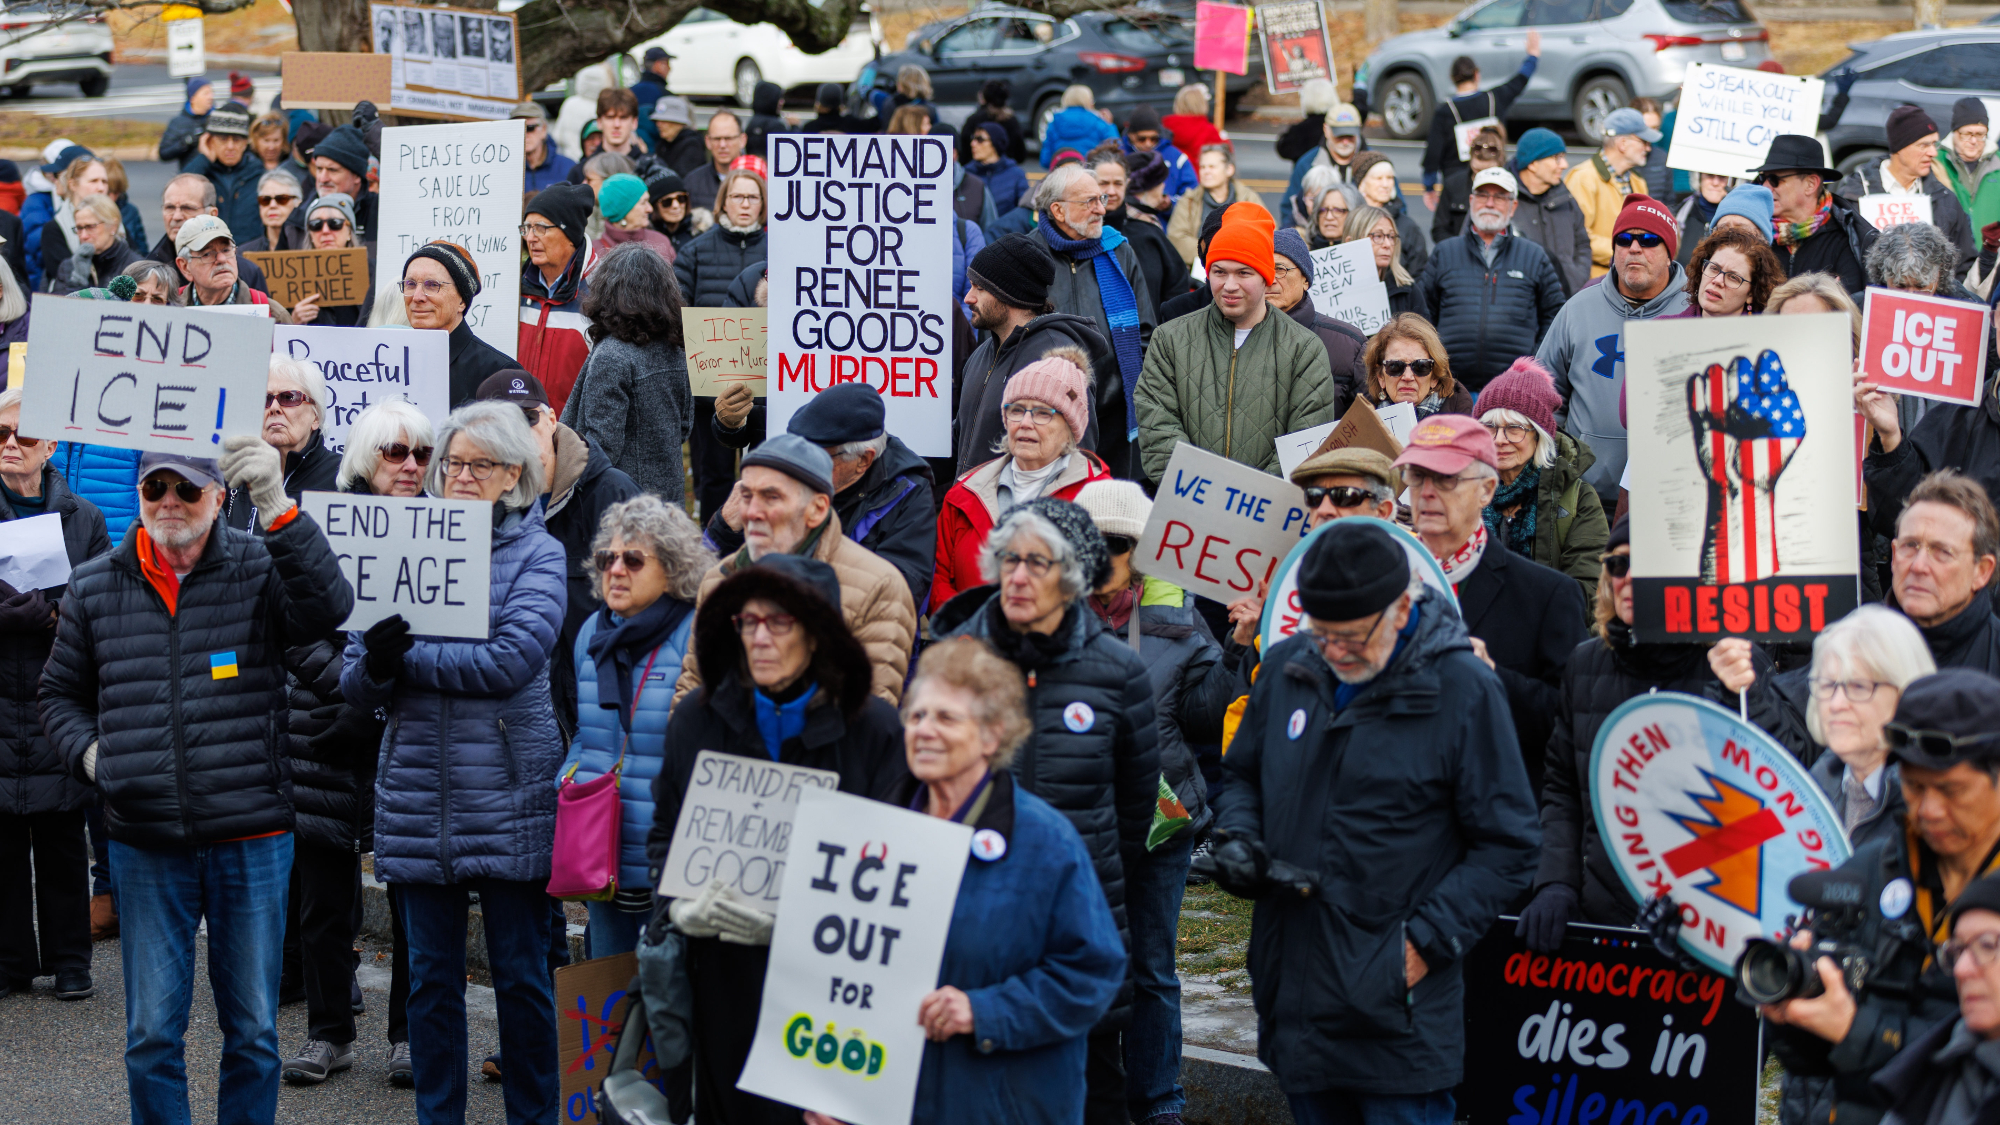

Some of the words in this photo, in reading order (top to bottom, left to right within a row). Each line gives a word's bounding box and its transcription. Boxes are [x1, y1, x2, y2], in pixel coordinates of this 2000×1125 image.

[1698, 93, 1753, 115] WHILE
[1762, 104, 1792, 122] YOU
[1700, 72, 1761, 98] SPEAK
[1764, 83, 1801, 102] OUT
[1688, 117, 1741, 143] STILL
[1746, 125, 1791, 146] CA
[399, 144, 463, 171] PLEASE
[471, 143, 510, 164] GOD
[774, 137, 948, 179] DEMAND
[470, 174, 491, 197] US
[774, 180, 937, 224] JUSTICE
[433, 206, 481, 227] FROM
[1878, 203, 1914, 215] ICE
[825, 224, 904, 266] FOR
[1311, 248, 1343, 264] WE
[257, 254, 353, 279] JUSTICE
[1311, 274, 1352, 296] SEEN
[1314, 260, 1355, 280] HAVE
[287, 278, 355, 302] RENEE
[795, 266, 920, 311] RENEE
[1330, 292, 1343, 307] IT
[94, 314, 212, 364] END
[704, 317, 754, 343] ICE
[792, 308, 945, 355] GOOD'S
[1892, 309, 1957, 352] ICE
[288, 338, 410, 387] Paceful
[689, 351, 723, 374] Terror
[778, 352, 939, 398] MURDER
[1881, 343, 1962, 386] OUT
[70, 368, 227, 445] ICE!
[1325, 420, 1358, 452] BOLISH
[1174, 469, 1212, 505] WE
[1225, 487, 1272, 522] THE
[327, 503, 390, 538] END
[405, 506, 467, 542] THE
[1155, 520, 1278, 598] RESI
[393, 556, 467, 606] AGE
[1663, 583, 1829, 633] RESIST
[696, 758, 784, 798] STAND
[1613, 723, 1671, 793] THEN
[1720, 738, 1804, 818] NOW
[1614, 804, 1673, 898] KING
[810, 841, 918, 908] ICE
[812, 914, 901, 966] OUT
[829, 977, 874, 1010] FOR
[1504, 950, 1725, 1026] democracy
[784, 1014, 886, 1078] GOOD
[1517, 999, 1631, 1070] dies
[1650, 1013, 1707, 1079] in
